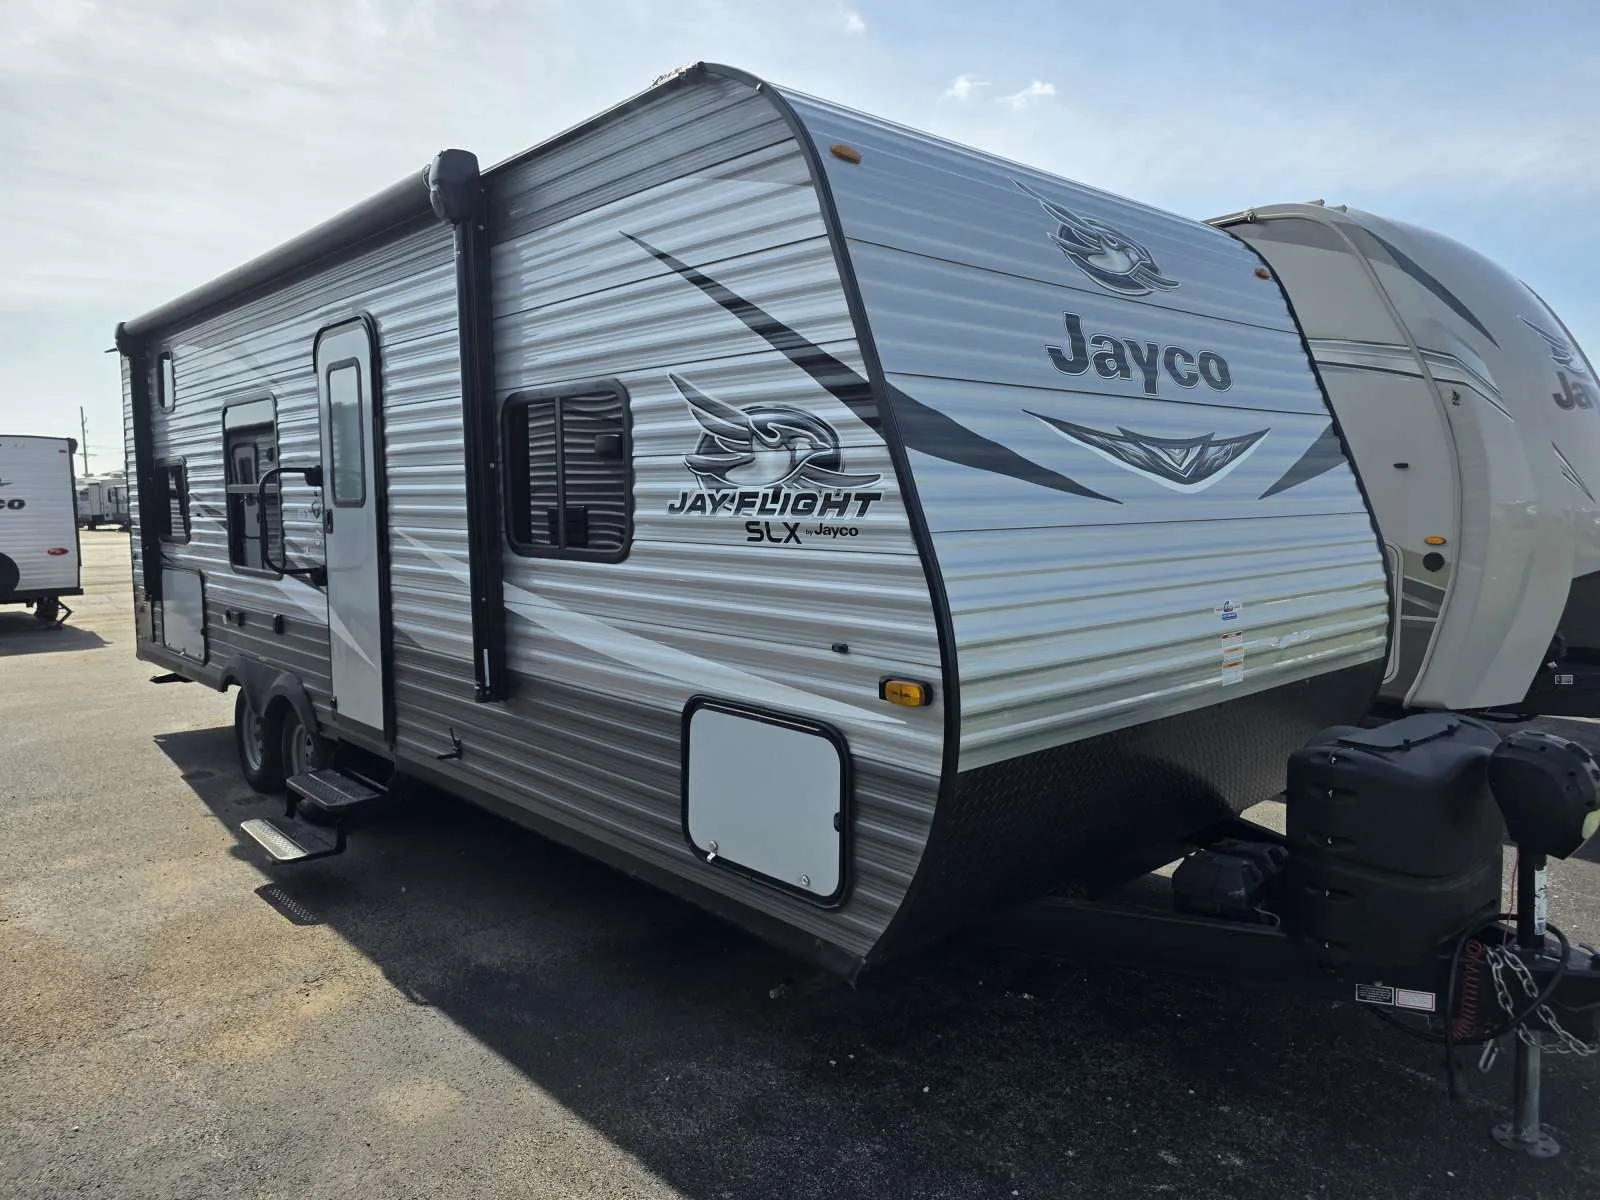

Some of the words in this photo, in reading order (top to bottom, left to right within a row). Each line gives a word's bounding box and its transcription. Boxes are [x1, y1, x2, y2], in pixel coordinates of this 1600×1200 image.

[1045, 311, 1232, 396] Jayco
[732, 490, 883, 518] FLIGHT
[744, 520, 803, 545] SLX
[805, 528, 814, 536] by
[814, 523, 859, 539] Jayco
